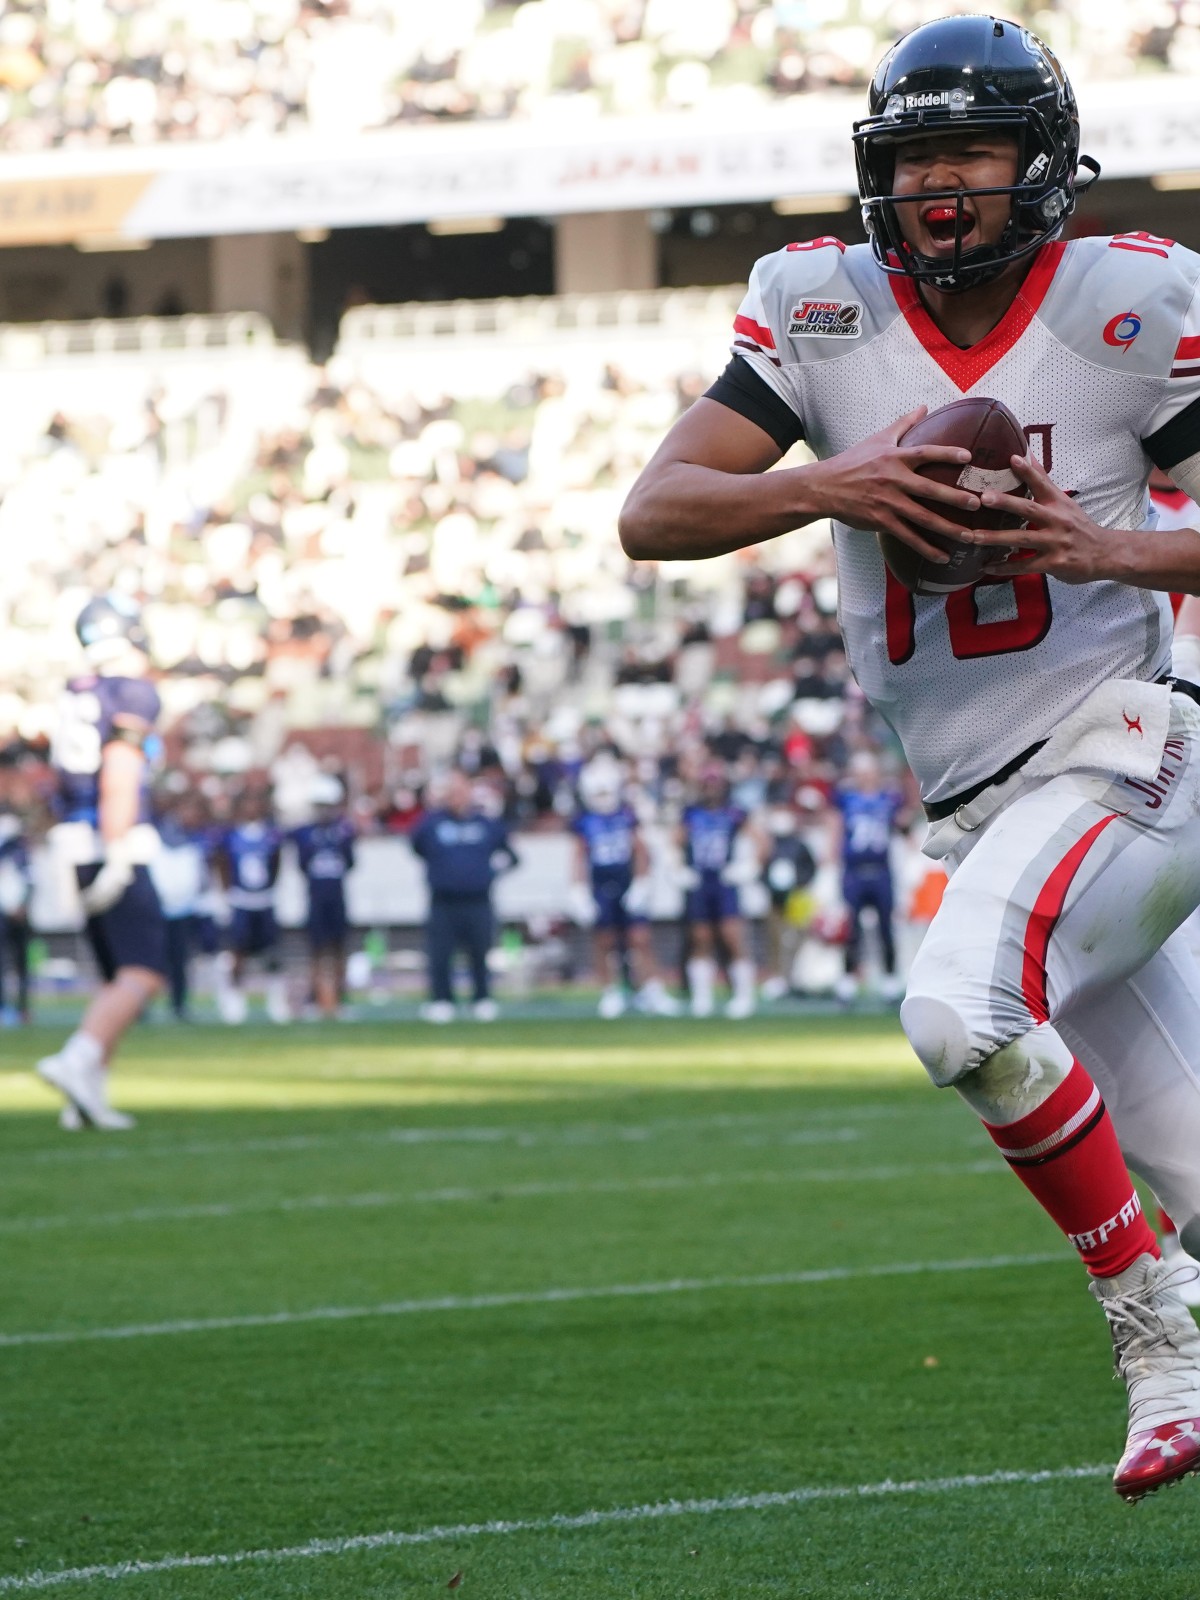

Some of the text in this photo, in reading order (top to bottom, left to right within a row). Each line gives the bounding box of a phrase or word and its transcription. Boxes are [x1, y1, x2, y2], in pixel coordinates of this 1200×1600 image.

[905, 91, 950, 108] Riddell
[793, 302, 841, 320] JAPAN
[807, 310, 838, 325] U.S.
[790, 323, 859, 335] DREAM BOWL
